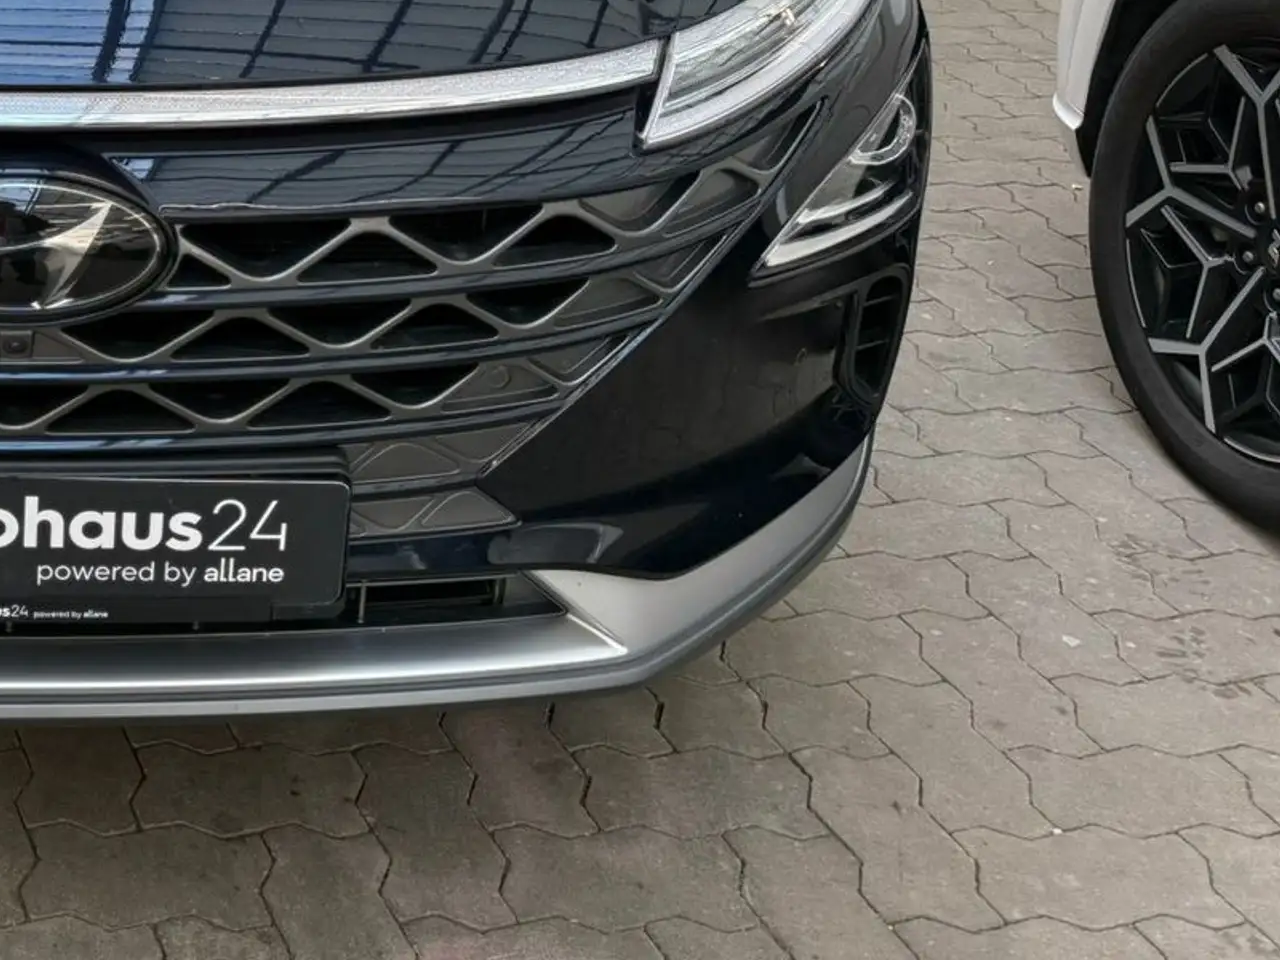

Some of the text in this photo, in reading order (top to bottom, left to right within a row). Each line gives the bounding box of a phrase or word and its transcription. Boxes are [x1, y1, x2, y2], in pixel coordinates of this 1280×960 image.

[37, 557, 284, 587] powered by allane
